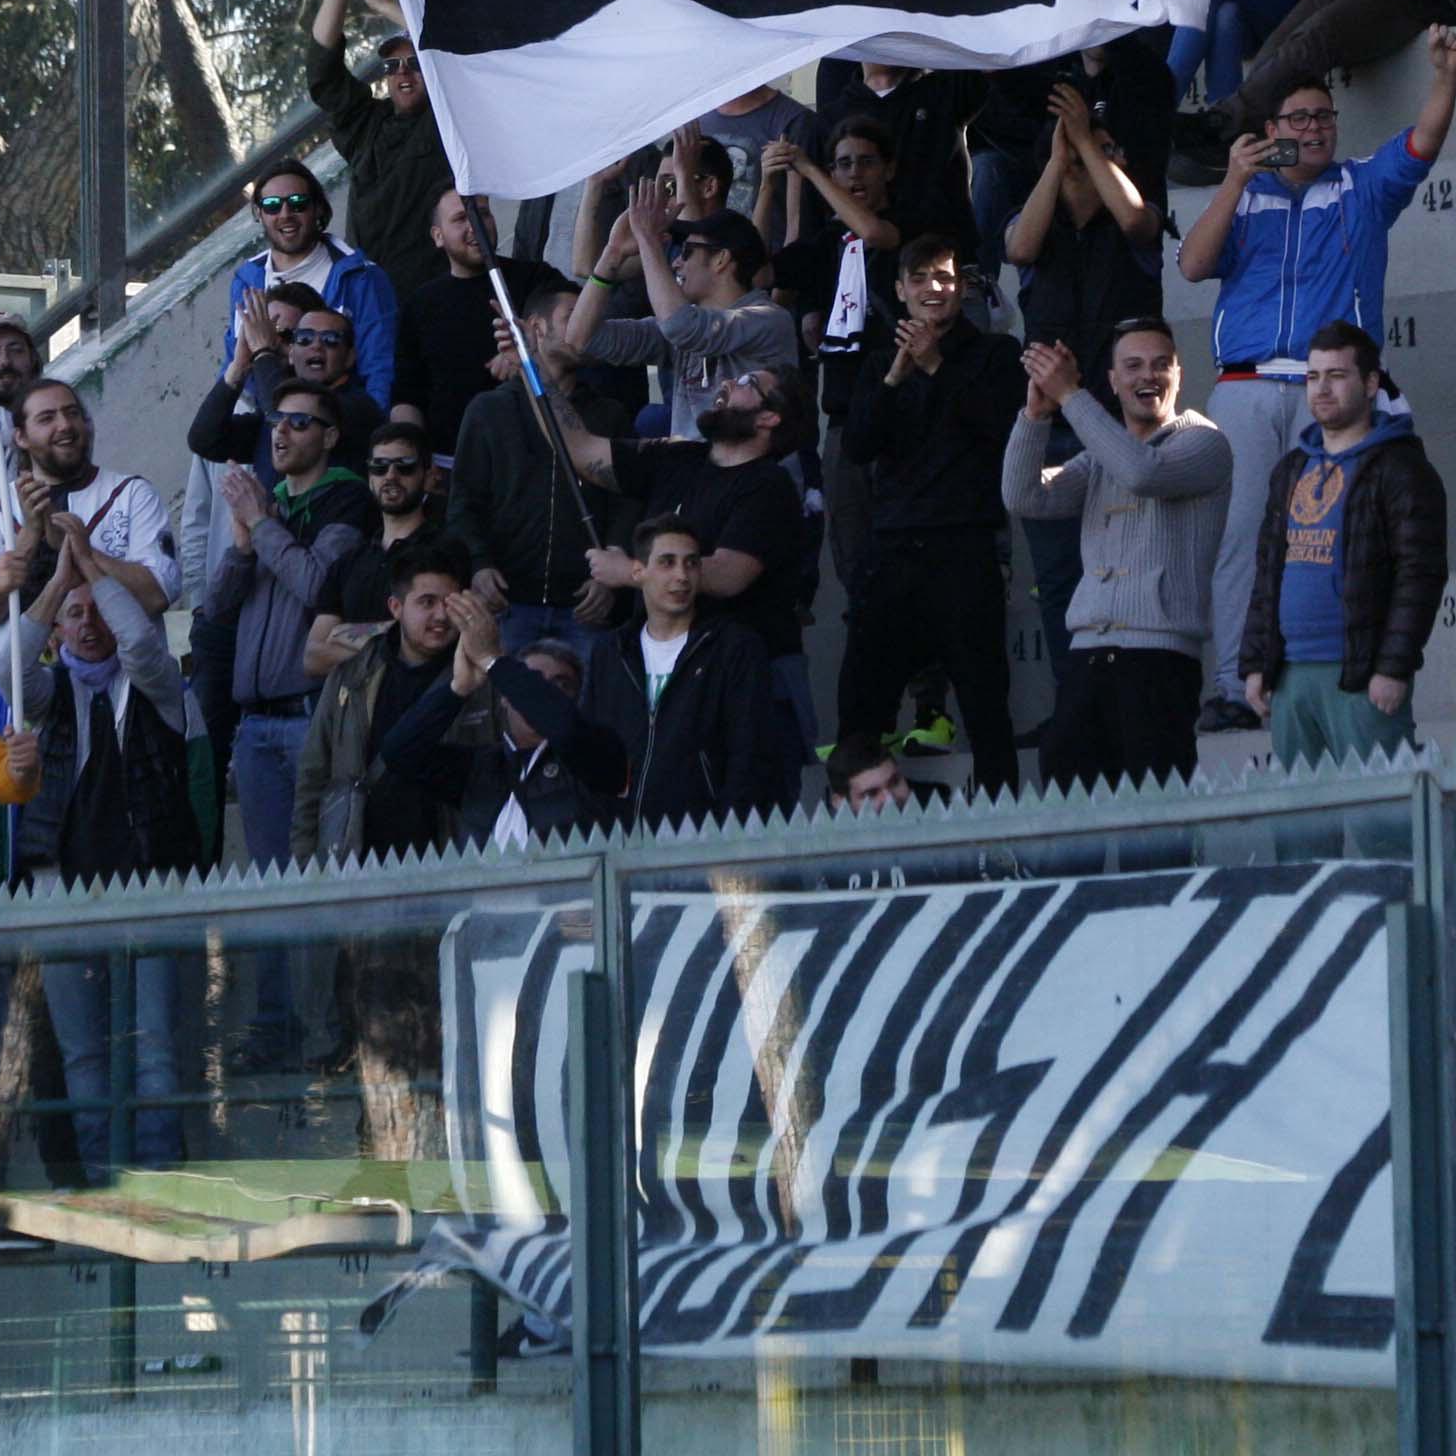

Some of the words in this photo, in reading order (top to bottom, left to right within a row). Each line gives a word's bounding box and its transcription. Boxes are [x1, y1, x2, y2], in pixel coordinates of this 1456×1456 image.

[1422, 179, 1453, 212] 42
[1388, 316, 1417, 348] 41
[1012, 629, 1042, 662] 41
